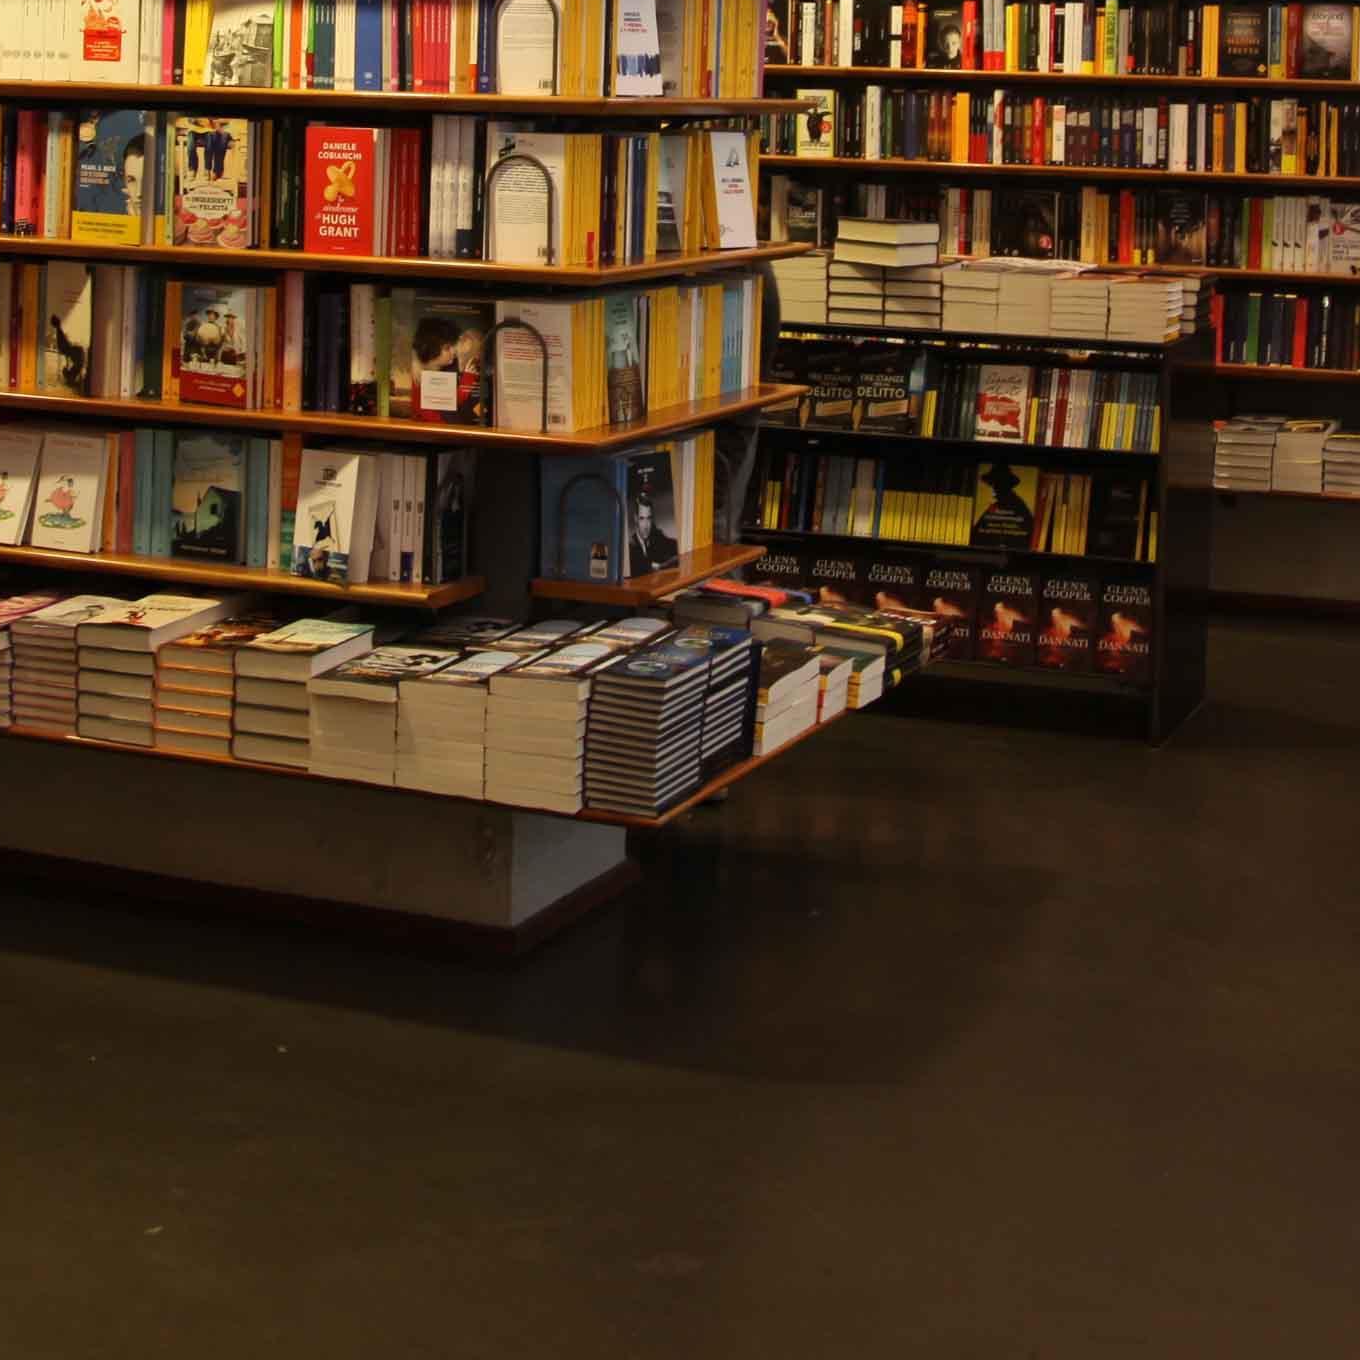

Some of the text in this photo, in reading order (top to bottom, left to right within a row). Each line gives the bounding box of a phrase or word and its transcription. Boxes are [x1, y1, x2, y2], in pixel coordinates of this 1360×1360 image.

[322, 142, 357, 151] DANIELE
[318, 151, 362, 160] COBIANCHI
[322, 214, 356, 225] HUGH
[319, 226, 360, 238] GRANT
[856, 386, 905, 399] DELITTO
[756, 562, 800, 575] COOPER
[816, 559, 854, 569] GLENN
[872, 563, 912, 575] GLENN
[812, 567, 856, 580] COOPER
[868, 571, 914, 585] COOPER
[929, 569, 969, 581] GLENN
[926, 577, 971, 591] COOPER
[991, 575, 1030, 585] GLENN
[1047, 579, 1088, 591] GLENN
[987, 583, 1033, 595] COOPER
[1043, 588, 1091, 601] COOPER
[1107, 584, 1148, 596] GLENN
[1103, 593, 1150, 607] COOPER
[981, 630, 1031, 643] DANNATI
[1039, 635, 1089, 649] DANNATI
[1099, 639, 1150, 655] DANNATI
